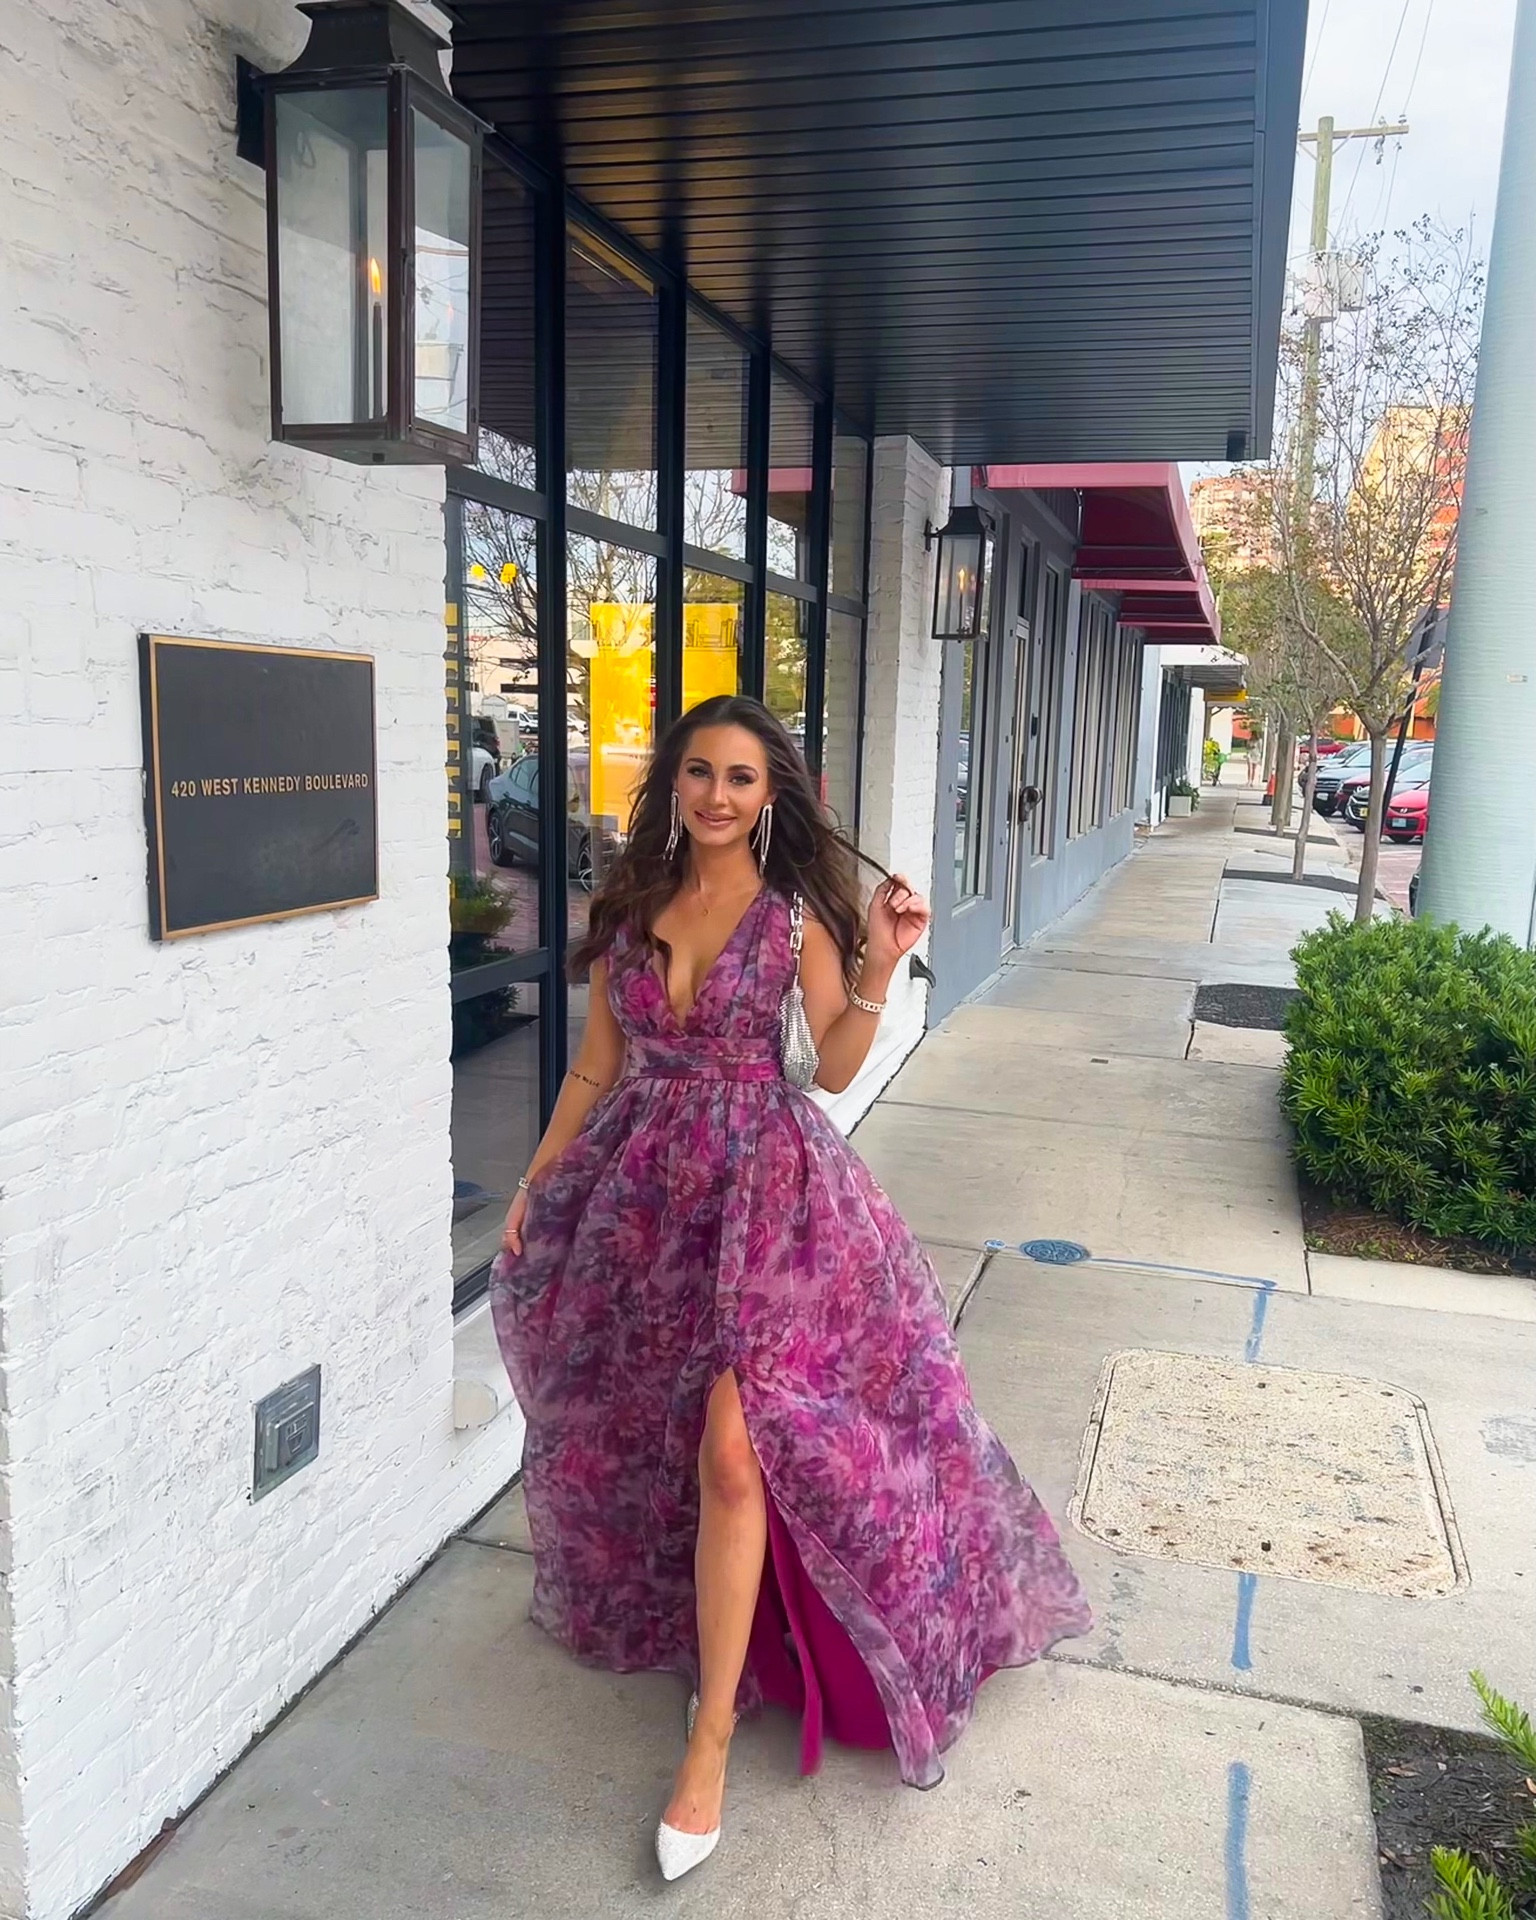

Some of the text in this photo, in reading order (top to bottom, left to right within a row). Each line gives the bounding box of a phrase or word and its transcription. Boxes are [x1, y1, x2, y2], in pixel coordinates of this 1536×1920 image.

[171, 773, 369, 797] 420 WEST KENNEDY BOULEVARD
